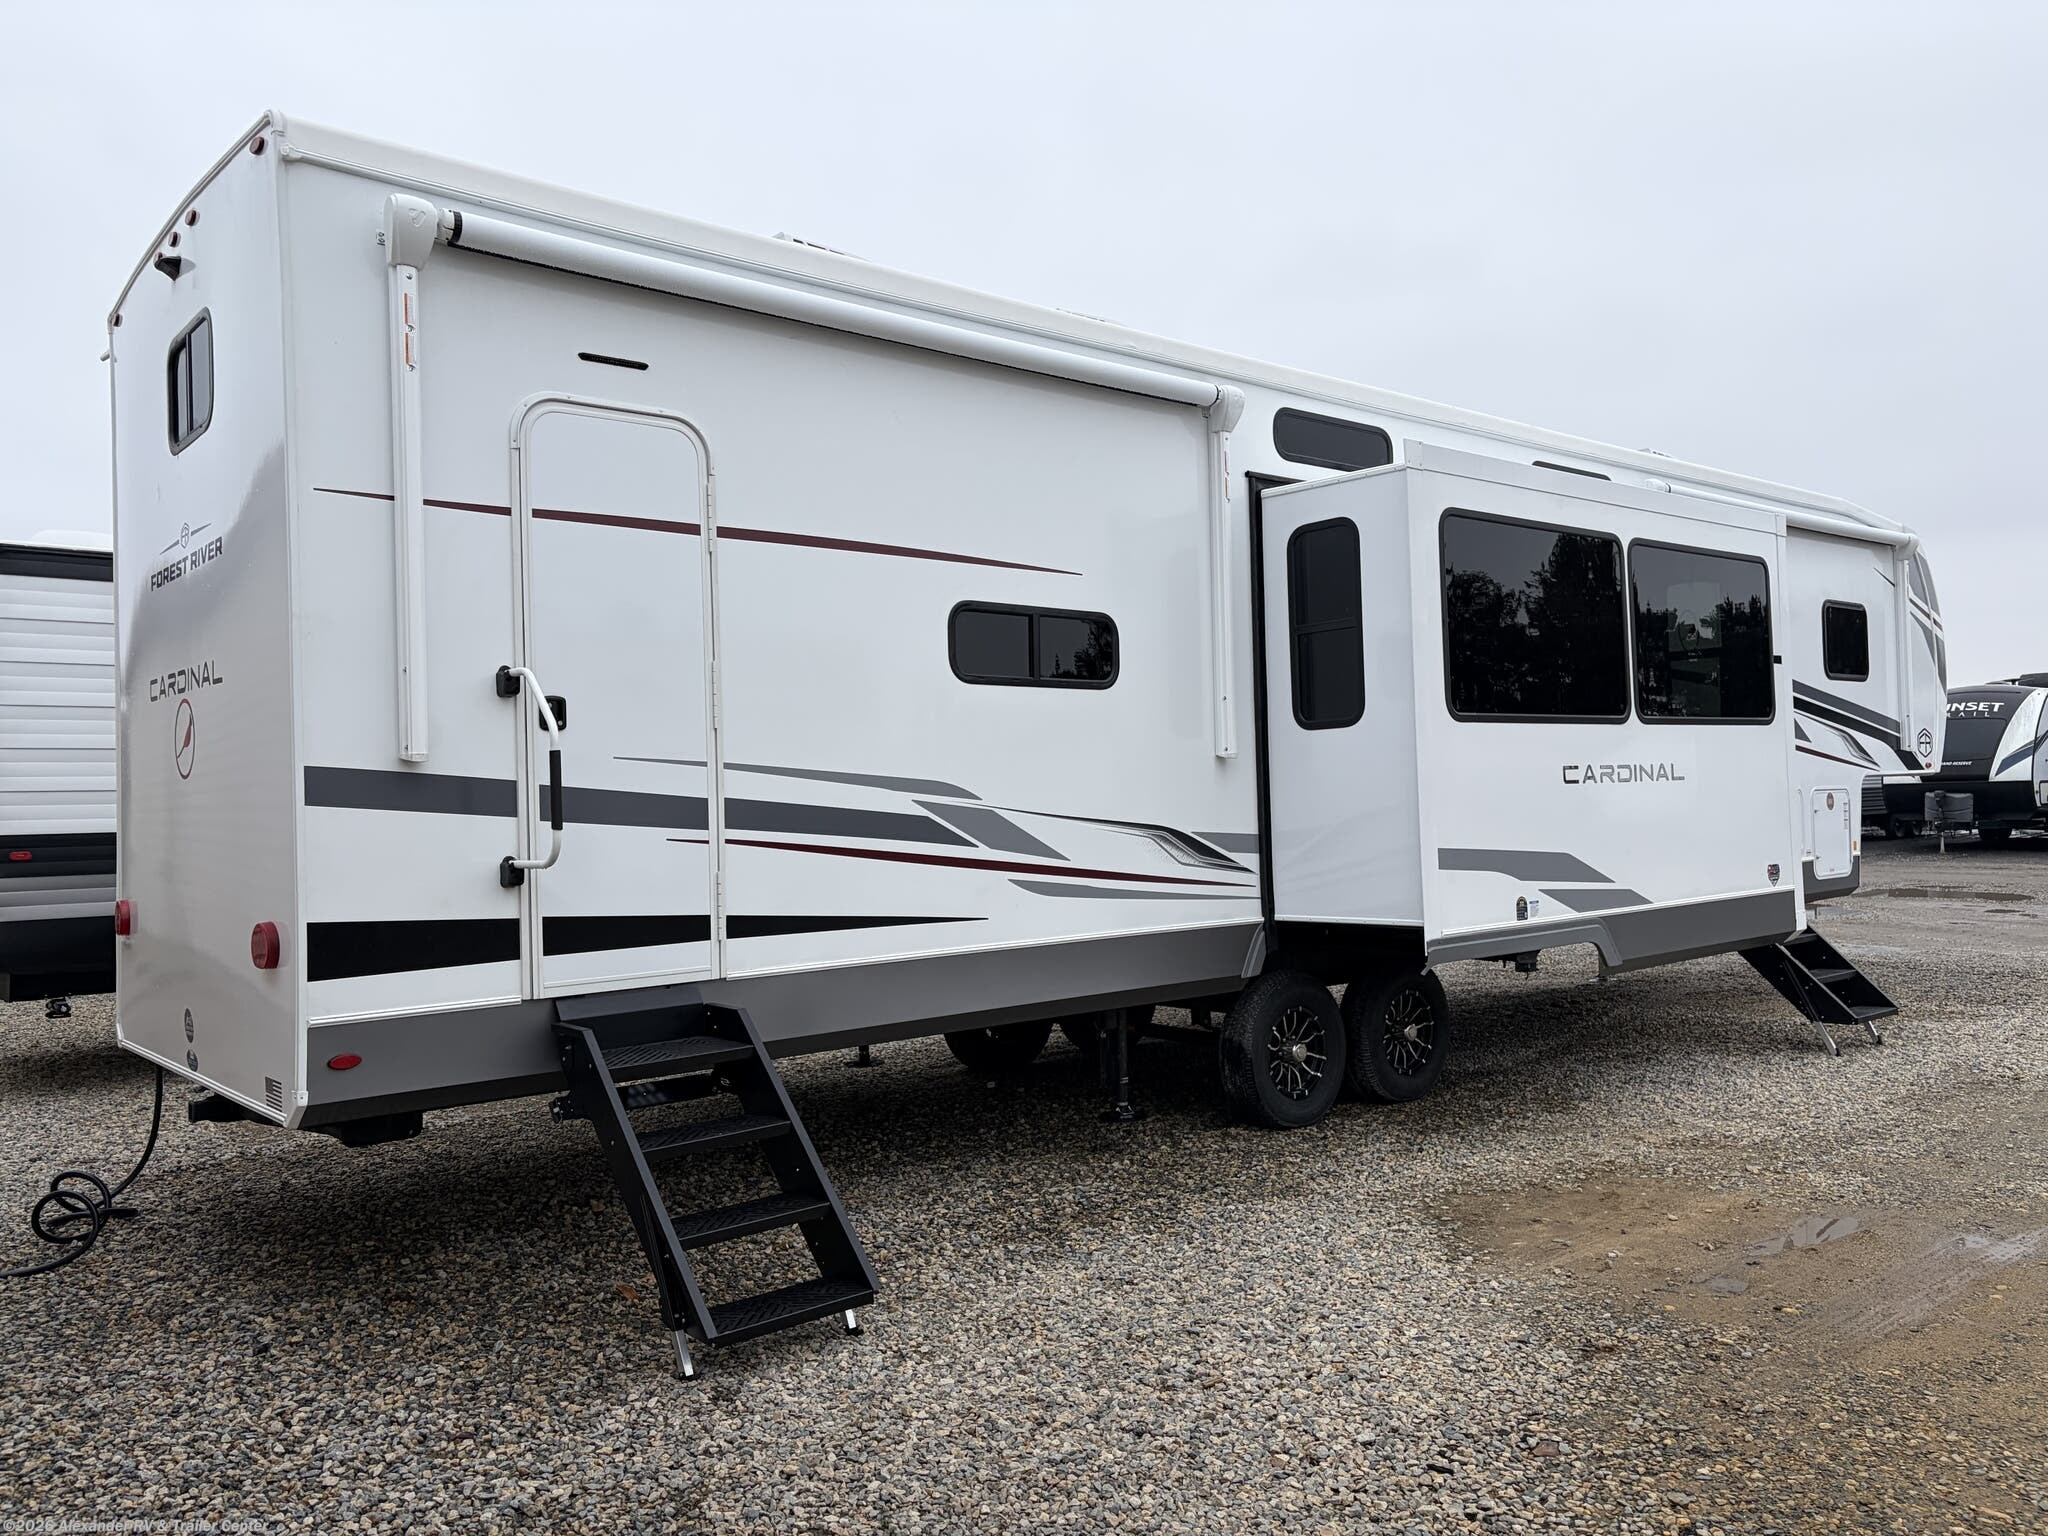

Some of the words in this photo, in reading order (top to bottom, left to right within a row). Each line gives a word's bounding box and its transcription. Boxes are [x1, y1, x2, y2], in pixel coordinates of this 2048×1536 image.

[151, 555, 189, 592] FOREST
[190, 536, 224, 571] RIVER
[150, 660, 224, 702] CARDINAL
[1946, 702, 2005, 712] NSET
[1562, 763, 1685, 785] CARDINAL
